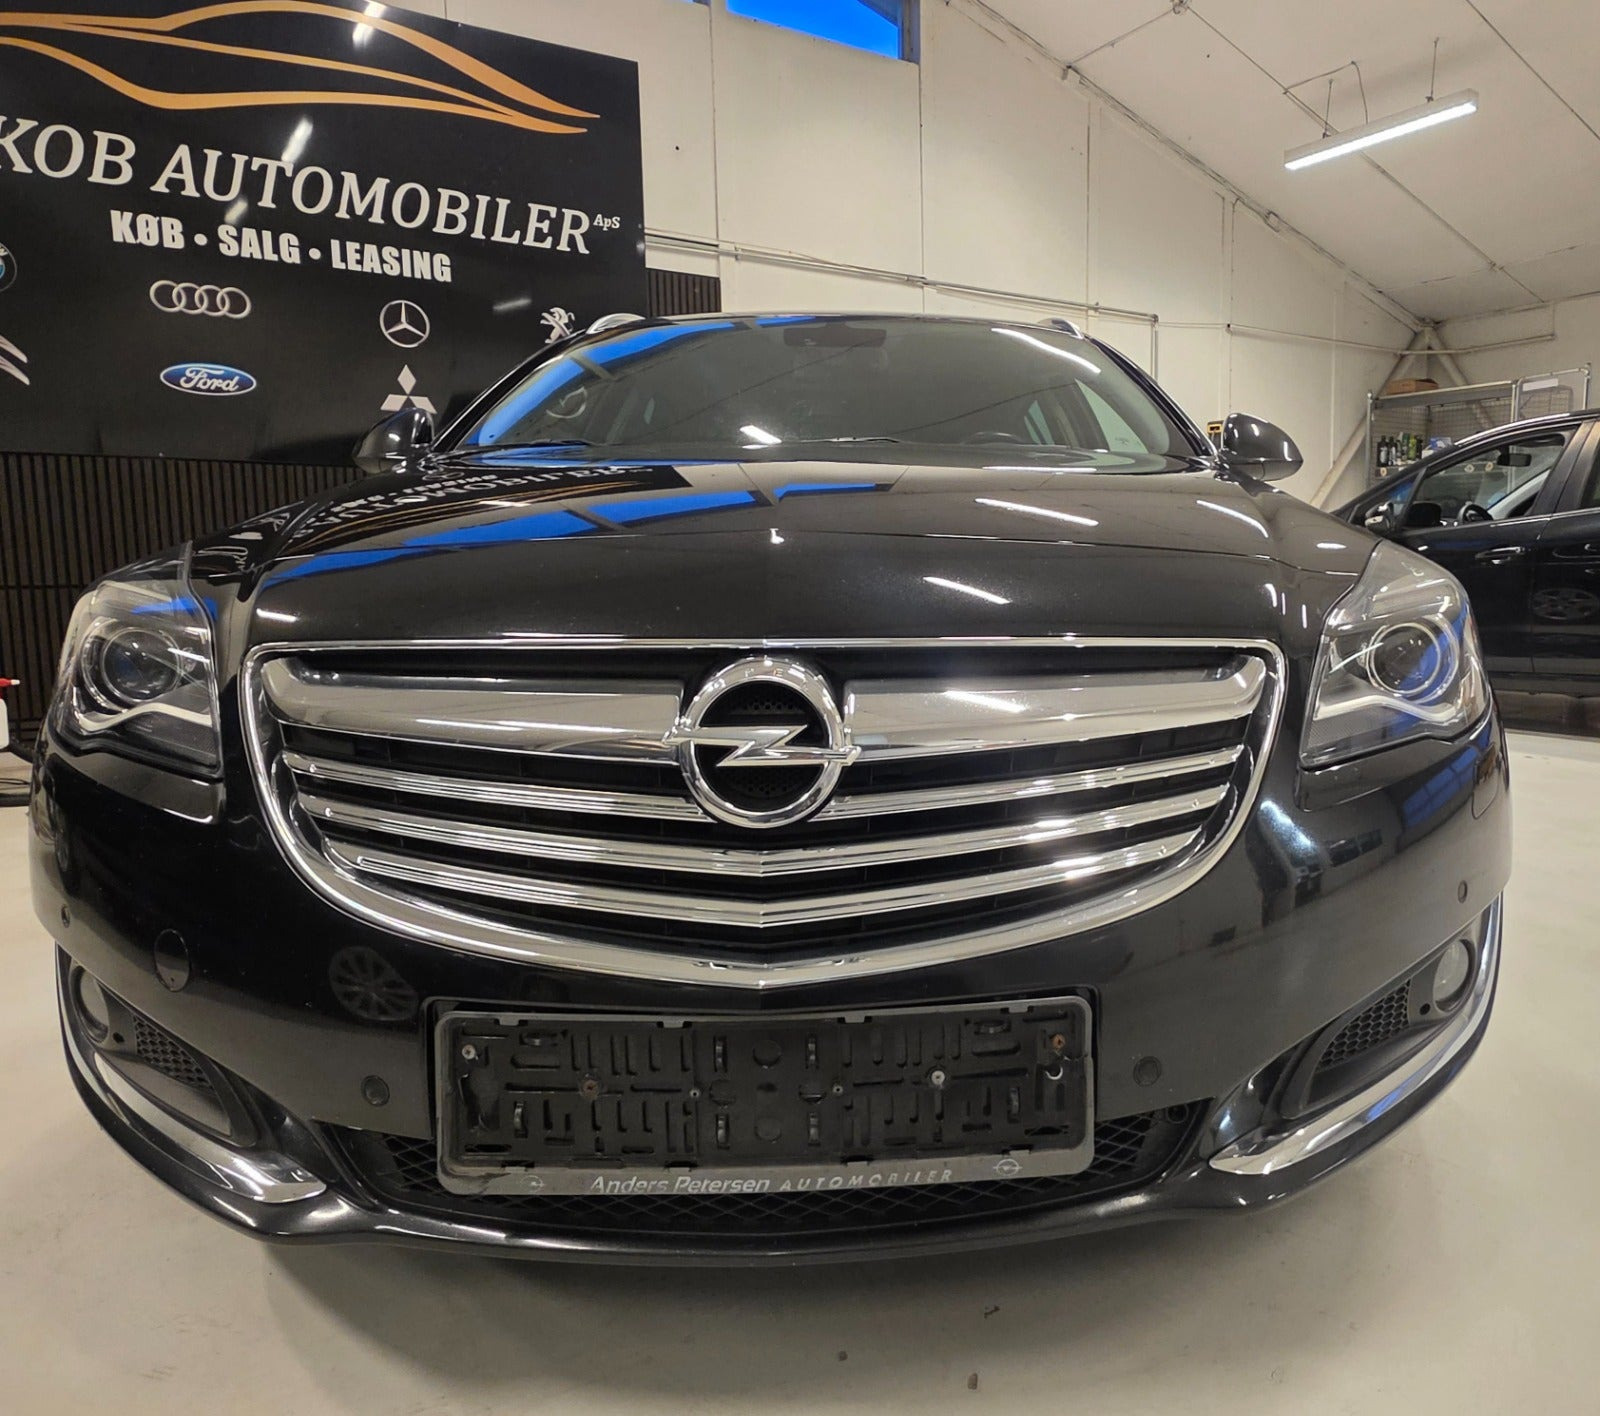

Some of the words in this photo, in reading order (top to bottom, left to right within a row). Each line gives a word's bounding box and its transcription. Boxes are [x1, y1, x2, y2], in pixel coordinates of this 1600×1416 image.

[149, 143, 590, 255] AUTOMOBILER
[592, 213, 621, 232] ApS
[110, 209, 185, 250] KØB
[218, 223, 301, 265] SALG
[330, 238, 452, 283] LEASING
[180, 367, 240, 392] Ford
[590, 1175, 669, 1194] Anders
[673, 1175, 771, 1194] Petersen
[779, 1169, 953, 1192] AUTOMOBILER
